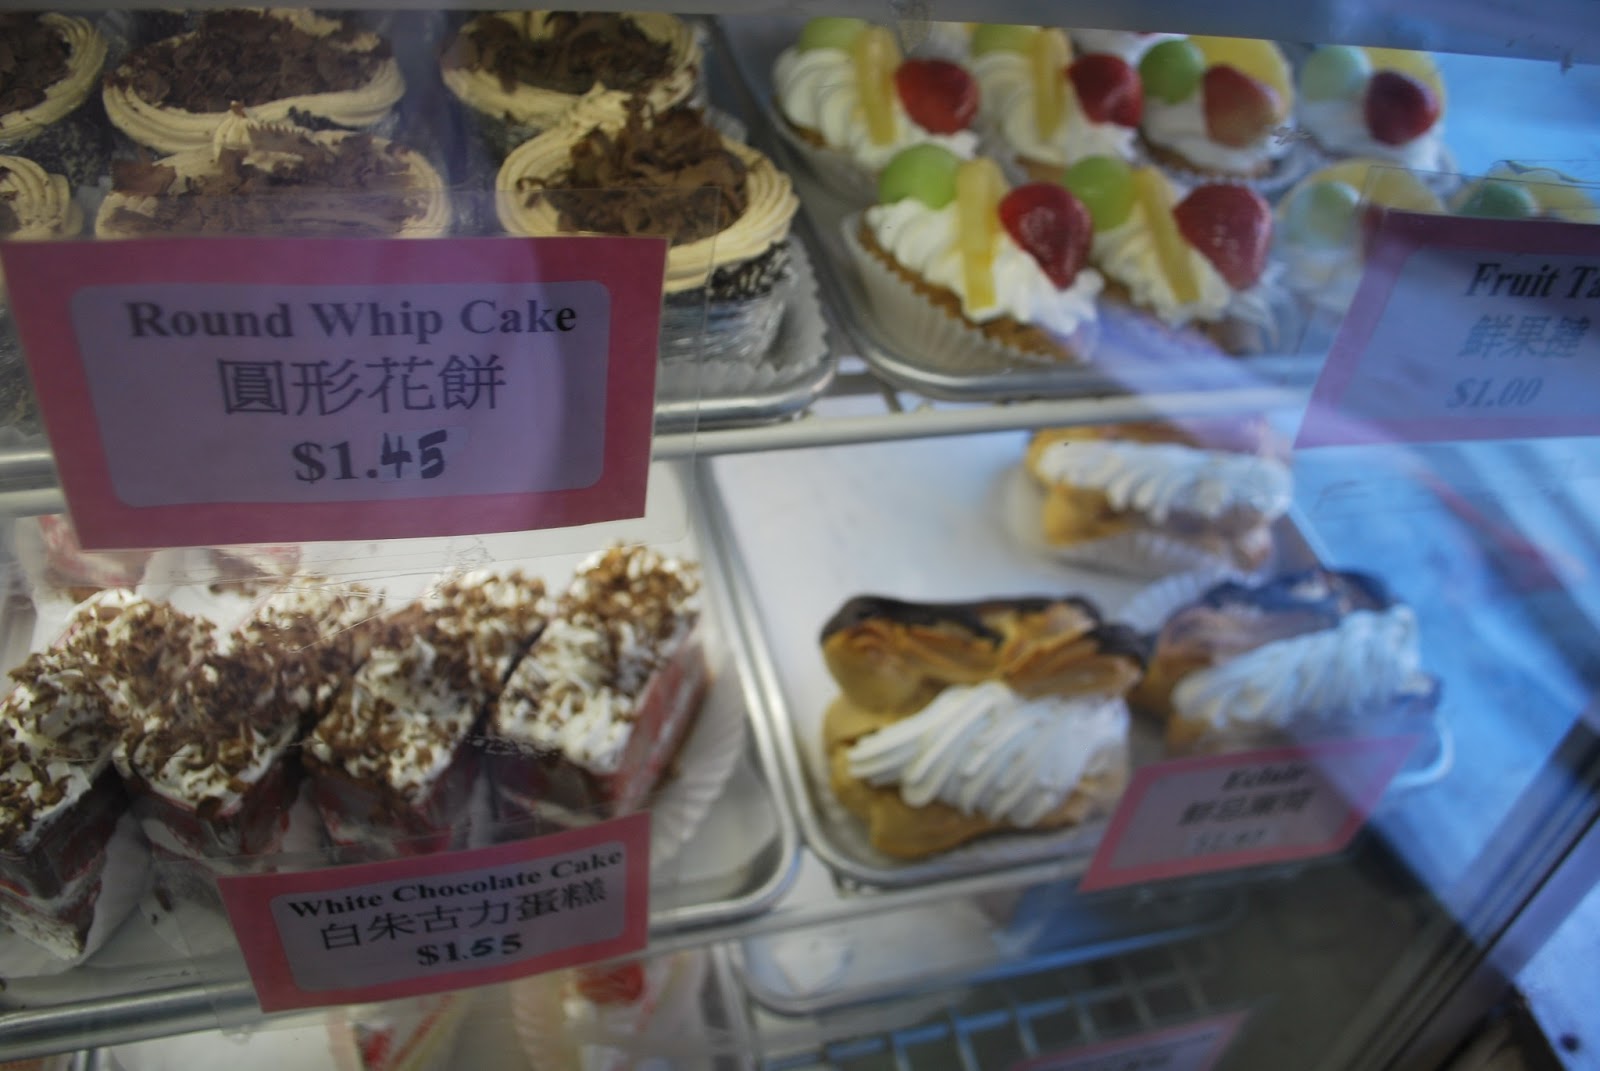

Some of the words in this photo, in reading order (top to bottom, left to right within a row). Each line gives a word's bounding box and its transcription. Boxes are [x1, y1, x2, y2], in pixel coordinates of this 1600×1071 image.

[1466, 262, 1559, 297] Fruit
[128, 300, 291, 338] Round
[309, 301, 442, 344] Whip
[459, 300, 578, 334] Cake
[218, 354, 507, 417] 圓形花餅
[293, 429, 449, 485] $1.45
[289, 893, 384, 919] White
[392, 870, 542, 903] Chocolate
[550, 849, 624, 880] Cake
[319, 876, 609, 951] 白朱古力蛋糕
[416, 933, 524, 967] $1.55
